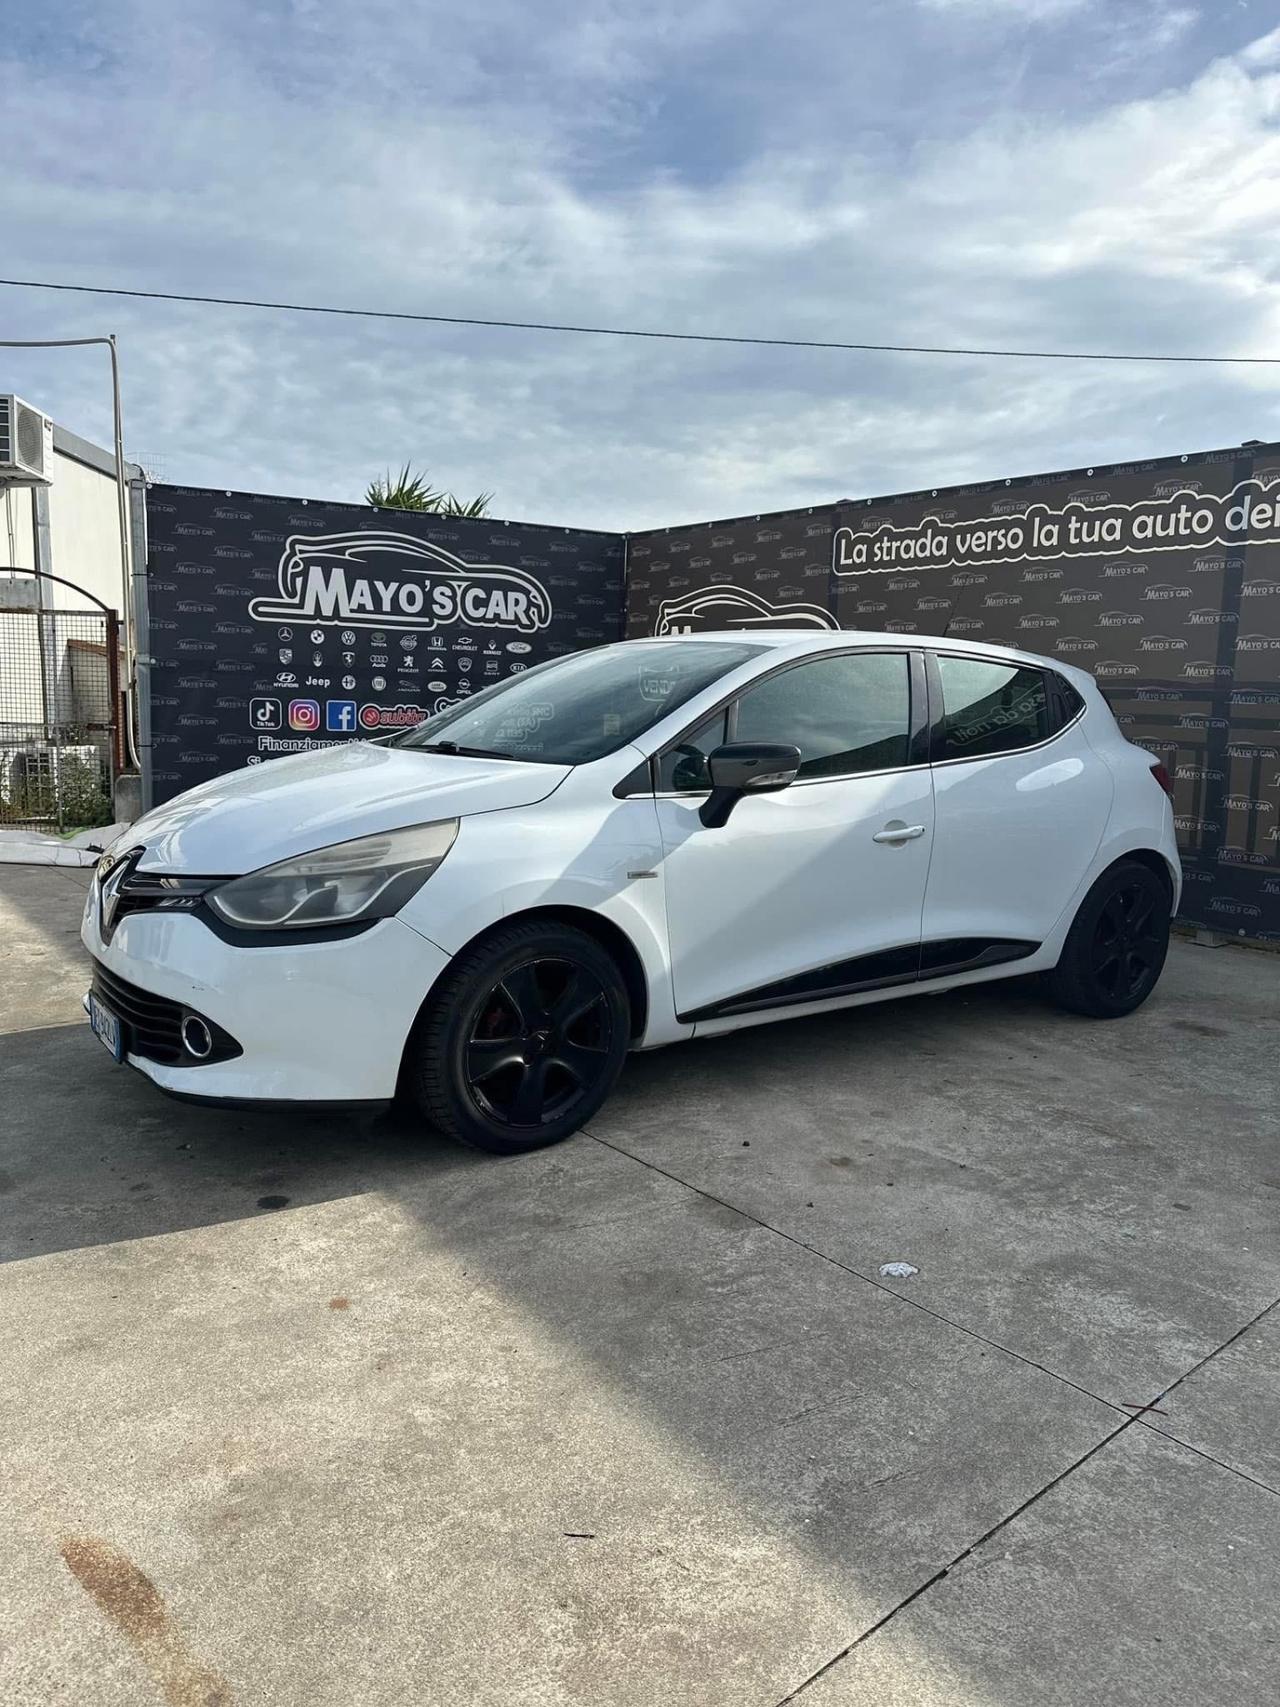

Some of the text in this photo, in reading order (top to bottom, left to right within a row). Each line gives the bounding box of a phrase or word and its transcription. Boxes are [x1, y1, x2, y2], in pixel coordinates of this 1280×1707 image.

[840, 538, 867, 564] La
[873, 529, 948, 562] strada
[956, 527, 1024, 554] verso
[1033, 517, 1059, 547] la
[1068, 515, 1122, 543] tua
[1132, 505, 1213, 538] auto
[303, 566, 531, 625] MAYO'S CAR
[305, 676, 330, 688] Jeep
